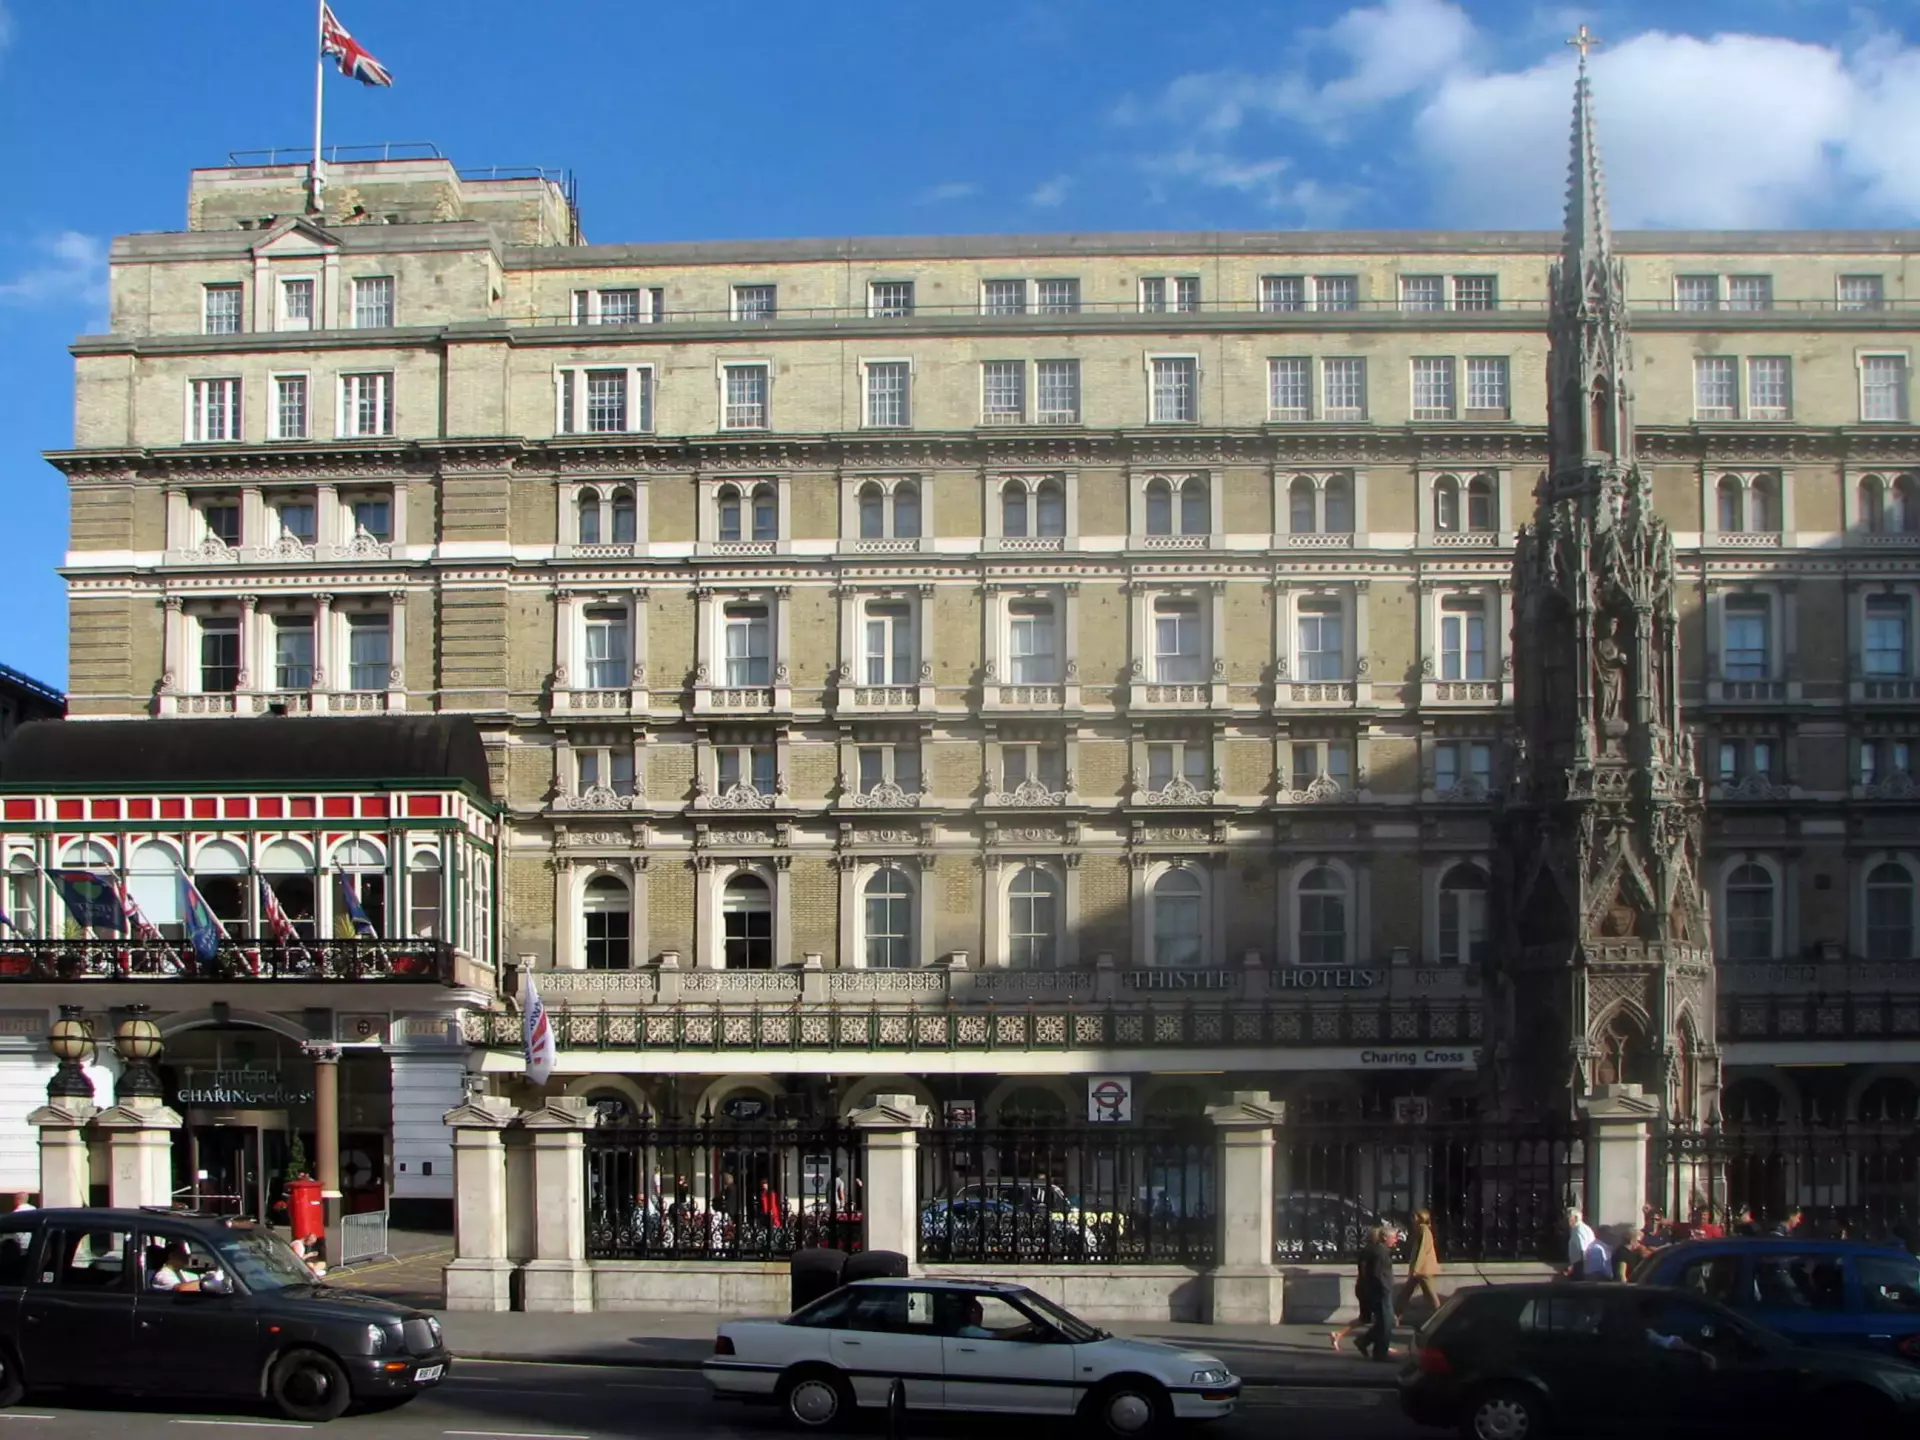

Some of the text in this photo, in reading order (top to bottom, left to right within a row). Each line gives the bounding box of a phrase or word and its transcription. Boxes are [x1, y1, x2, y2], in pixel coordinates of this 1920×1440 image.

[1134, 969, 1373, 989] THISTLE HOTELS
[1360, 1050, 1417, 1065] Charing
[1424, 1050, 1465, 1063] Cross
[178, 1089, 258, 1103] CHARING
